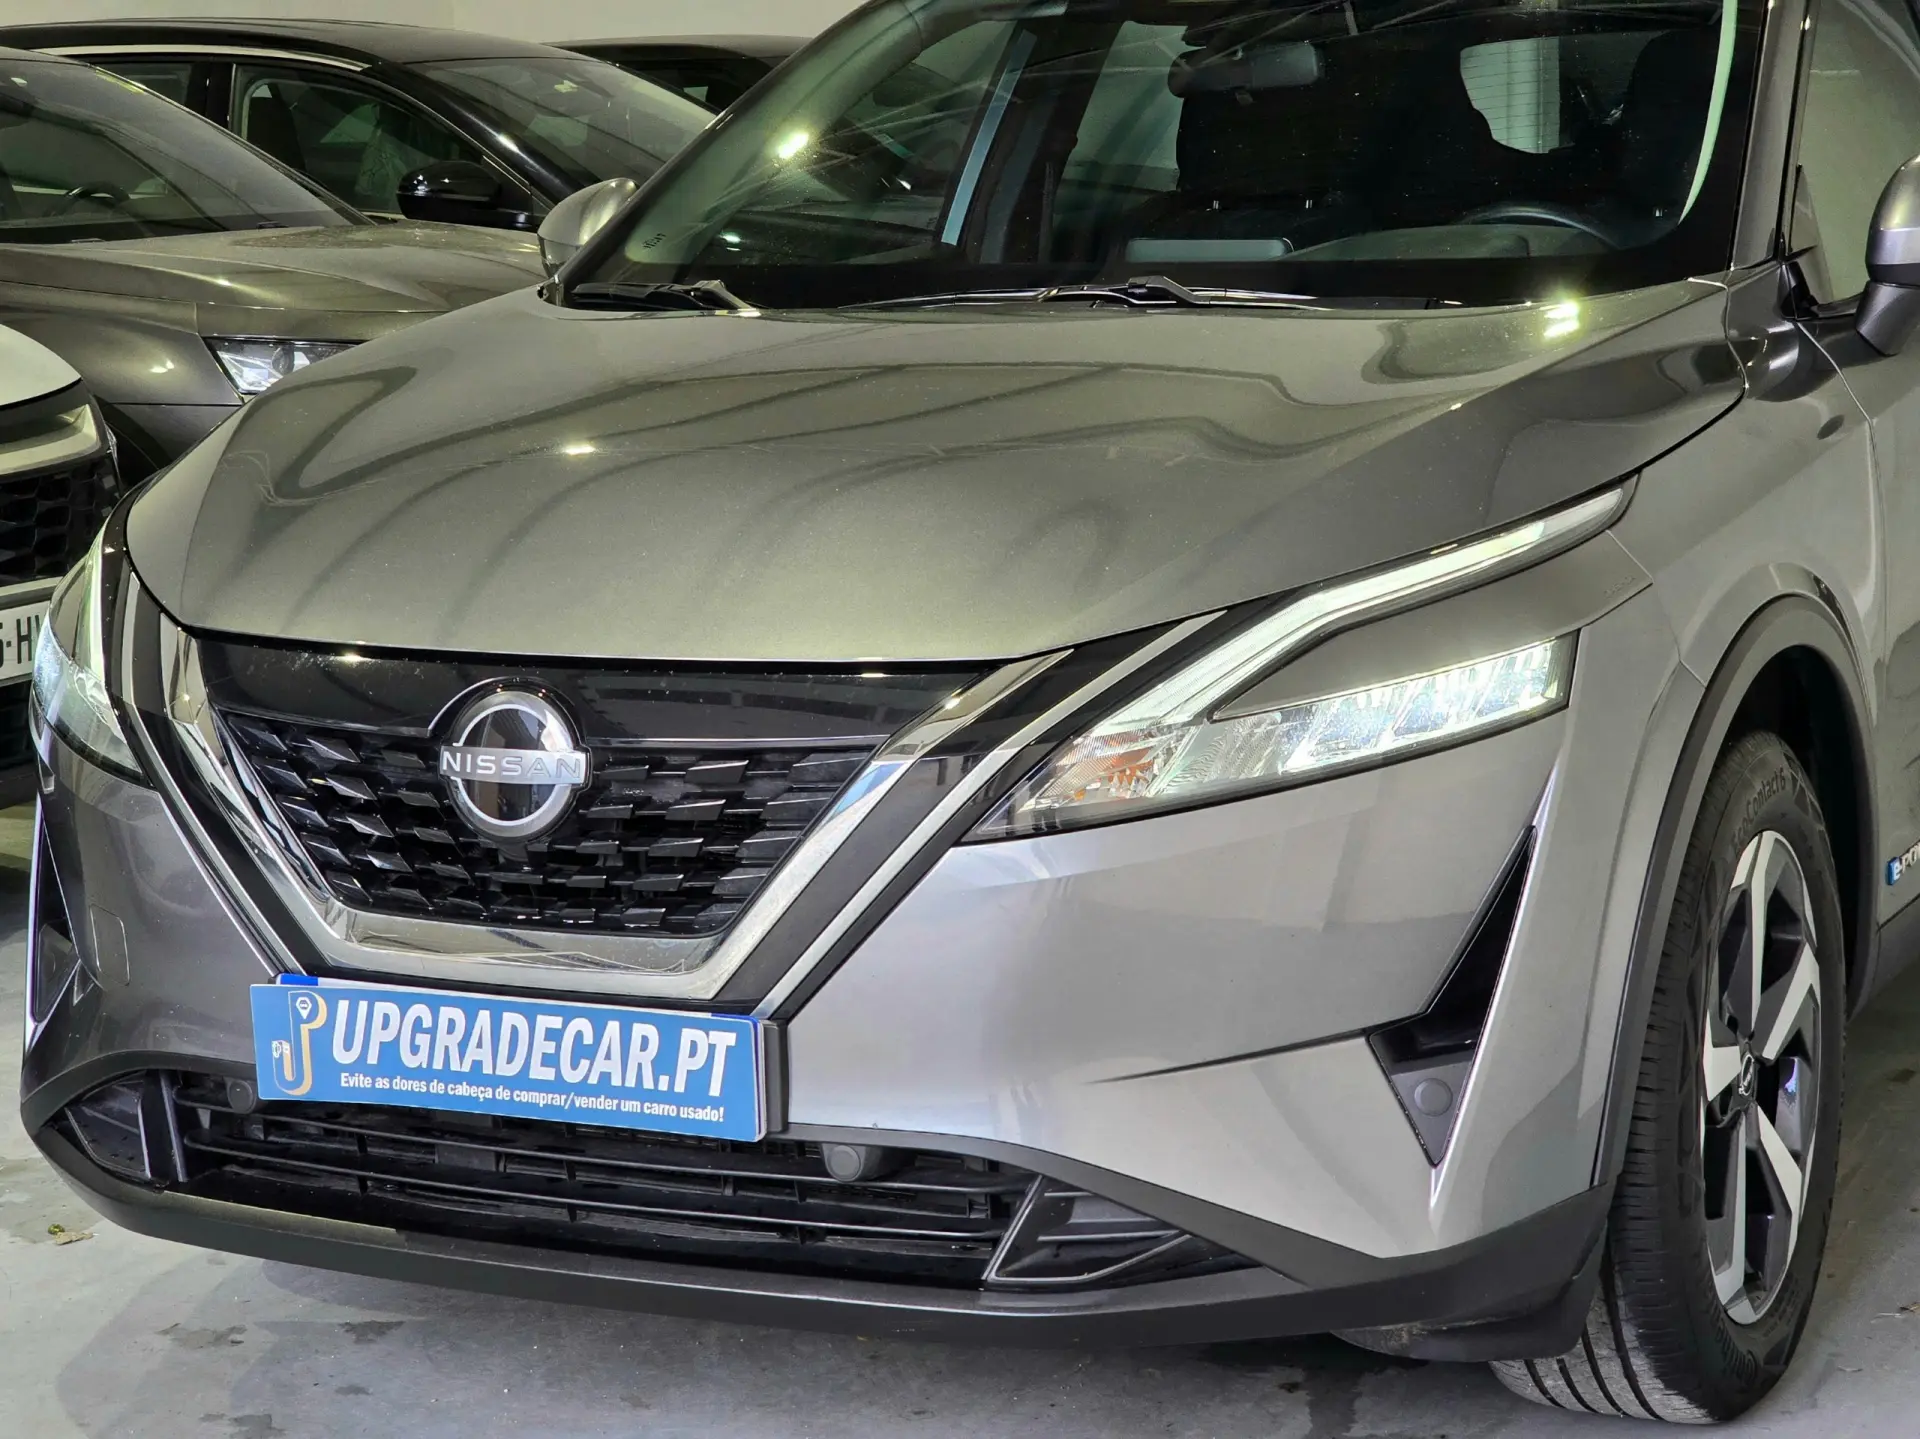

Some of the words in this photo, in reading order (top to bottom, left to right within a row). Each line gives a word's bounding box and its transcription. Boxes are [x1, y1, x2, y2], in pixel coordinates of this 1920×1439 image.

[442, 750, 581, 779] NISSAN
[332, 998, 737, 1097] UPGRADECAR.PT
[340, 1072, 372, 1088] Evite
[375, 1076, 390, 1089] as
[392, 1076, 428, 1093] dores
[429, 1079, 445, 1094] de
[447, 1081, 493, 1102] cabeça
[495, 1085, 511, 1101] de
[512, 1089, 619, 1113] comprar/vender
[620, 1099, 641, 1113] um
[643, 1101, 677, 1117] carro
[679, 1105, 725, 1123] usado!
